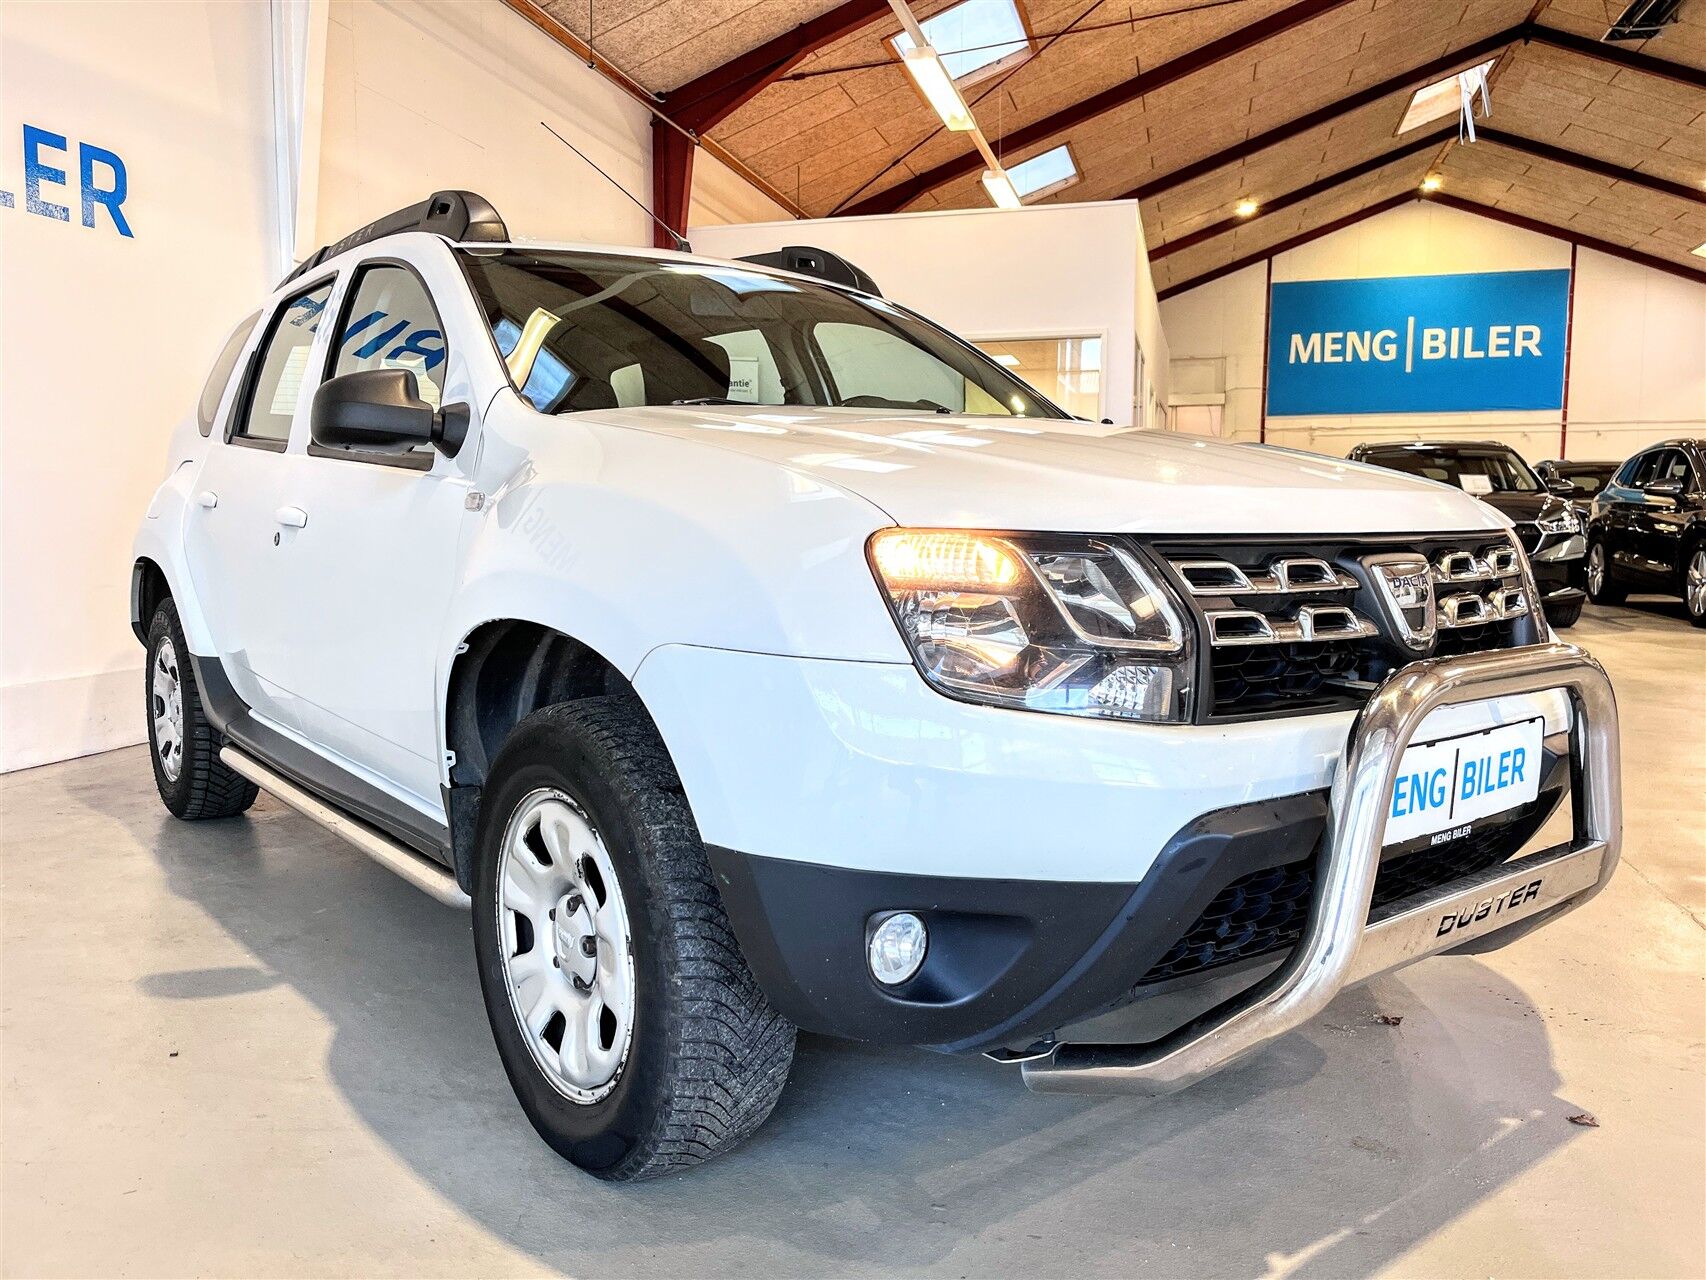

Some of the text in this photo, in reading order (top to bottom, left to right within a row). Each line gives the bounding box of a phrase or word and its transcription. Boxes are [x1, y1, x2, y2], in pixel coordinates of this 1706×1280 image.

[1288, 324, 1542, 364] MENG BILER
[729, 378, 750, 388] antie
[1392, 573, 1430, 589] DACIA
[1391, 747, 1526, 818] ENG BILER
[1430, 824, 1472, 846] MENG BILER
[1435, 879, 1543, 938] DUSTER
